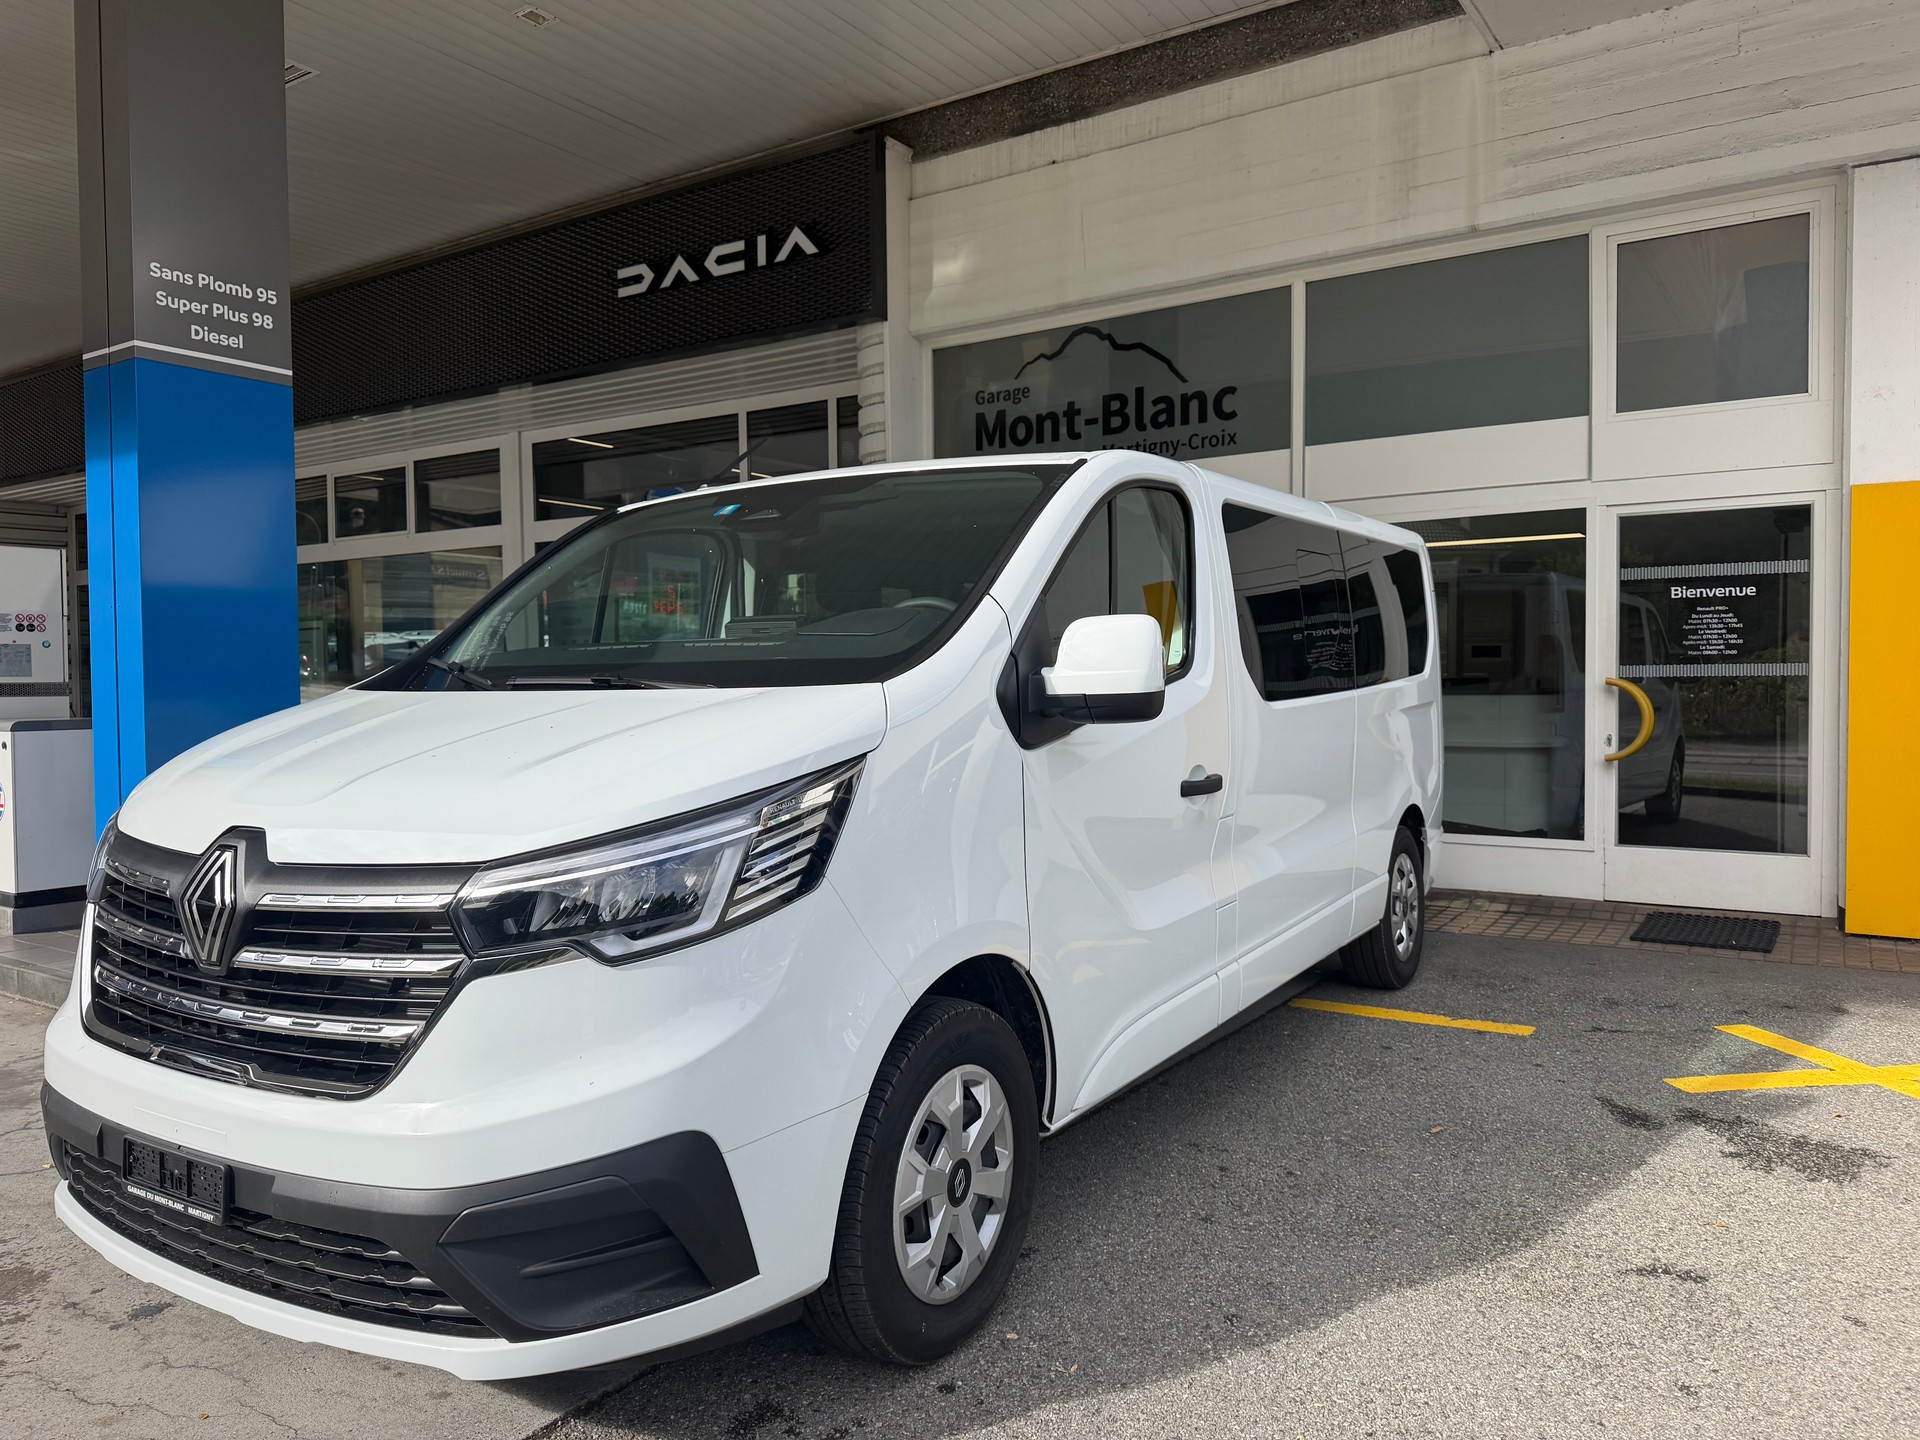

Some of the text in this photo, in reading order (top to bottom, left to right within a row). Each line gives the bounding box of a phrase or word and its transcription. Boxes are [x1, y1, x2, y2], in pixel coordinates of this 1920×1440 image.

[617, 225, 820, 298] DACIA
[150, 262, 278, 305] Sans Plomb 95
[156, 290, 274, 330] Super Plus 98
[190, 324, 244, 349] Diesel
[975, 385, 1031, 405] Garage
[975, 385, 1239, 451] Mont-Blanc
[1670, 585, 1757, 599] Bienvenue
[769, 798, 796, 813] RENAULT
[127, 1185, 214, 1222] GARAGE DU MONT-BLANC MARTIGNY
